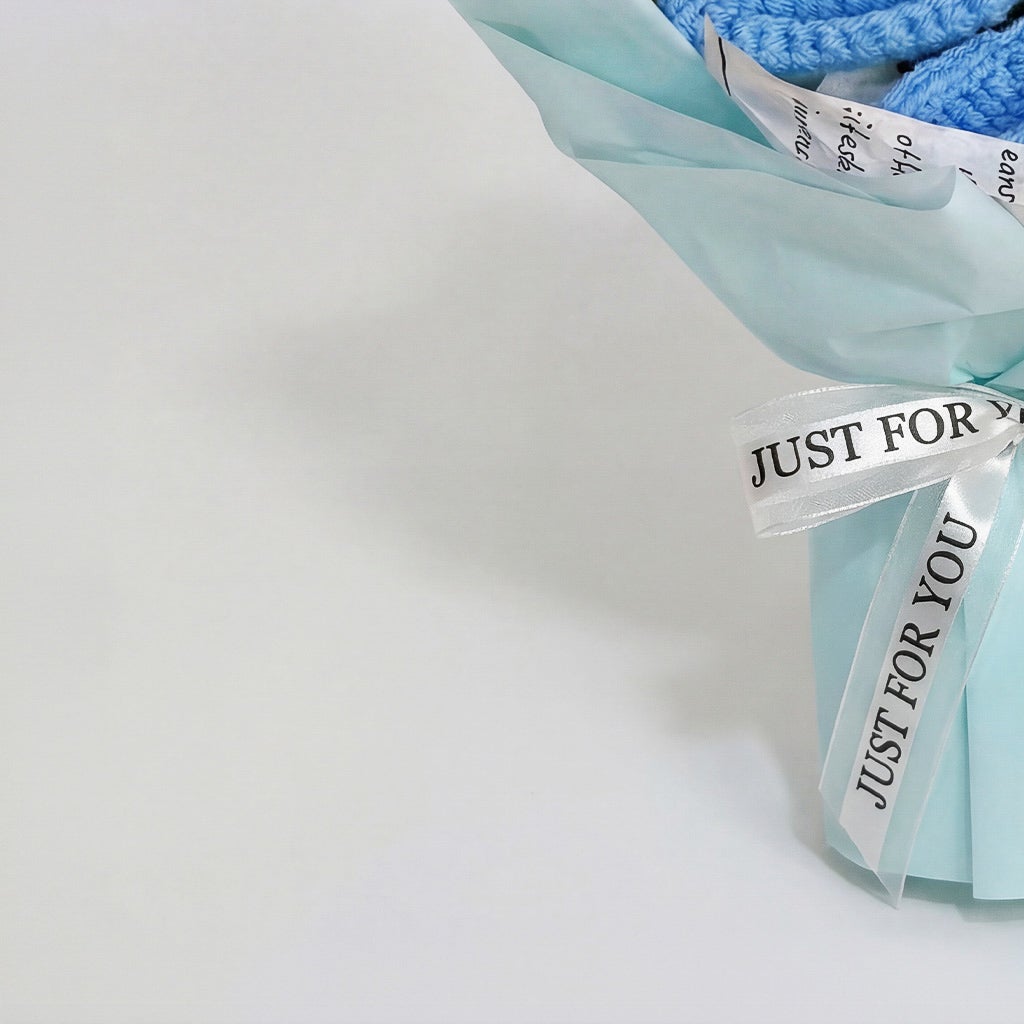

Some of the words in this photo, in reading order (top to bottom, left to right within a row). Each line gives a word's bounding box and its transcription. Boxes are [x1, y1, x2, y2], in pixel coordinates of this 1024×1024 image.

[751, 421, 863, 488] JUST
[876, 402, 980, 453] FOR
[856, 706, 909, 810] JUST
[883, 622, 941, 711] FOR
[912, 511, 978, 612] YOU
